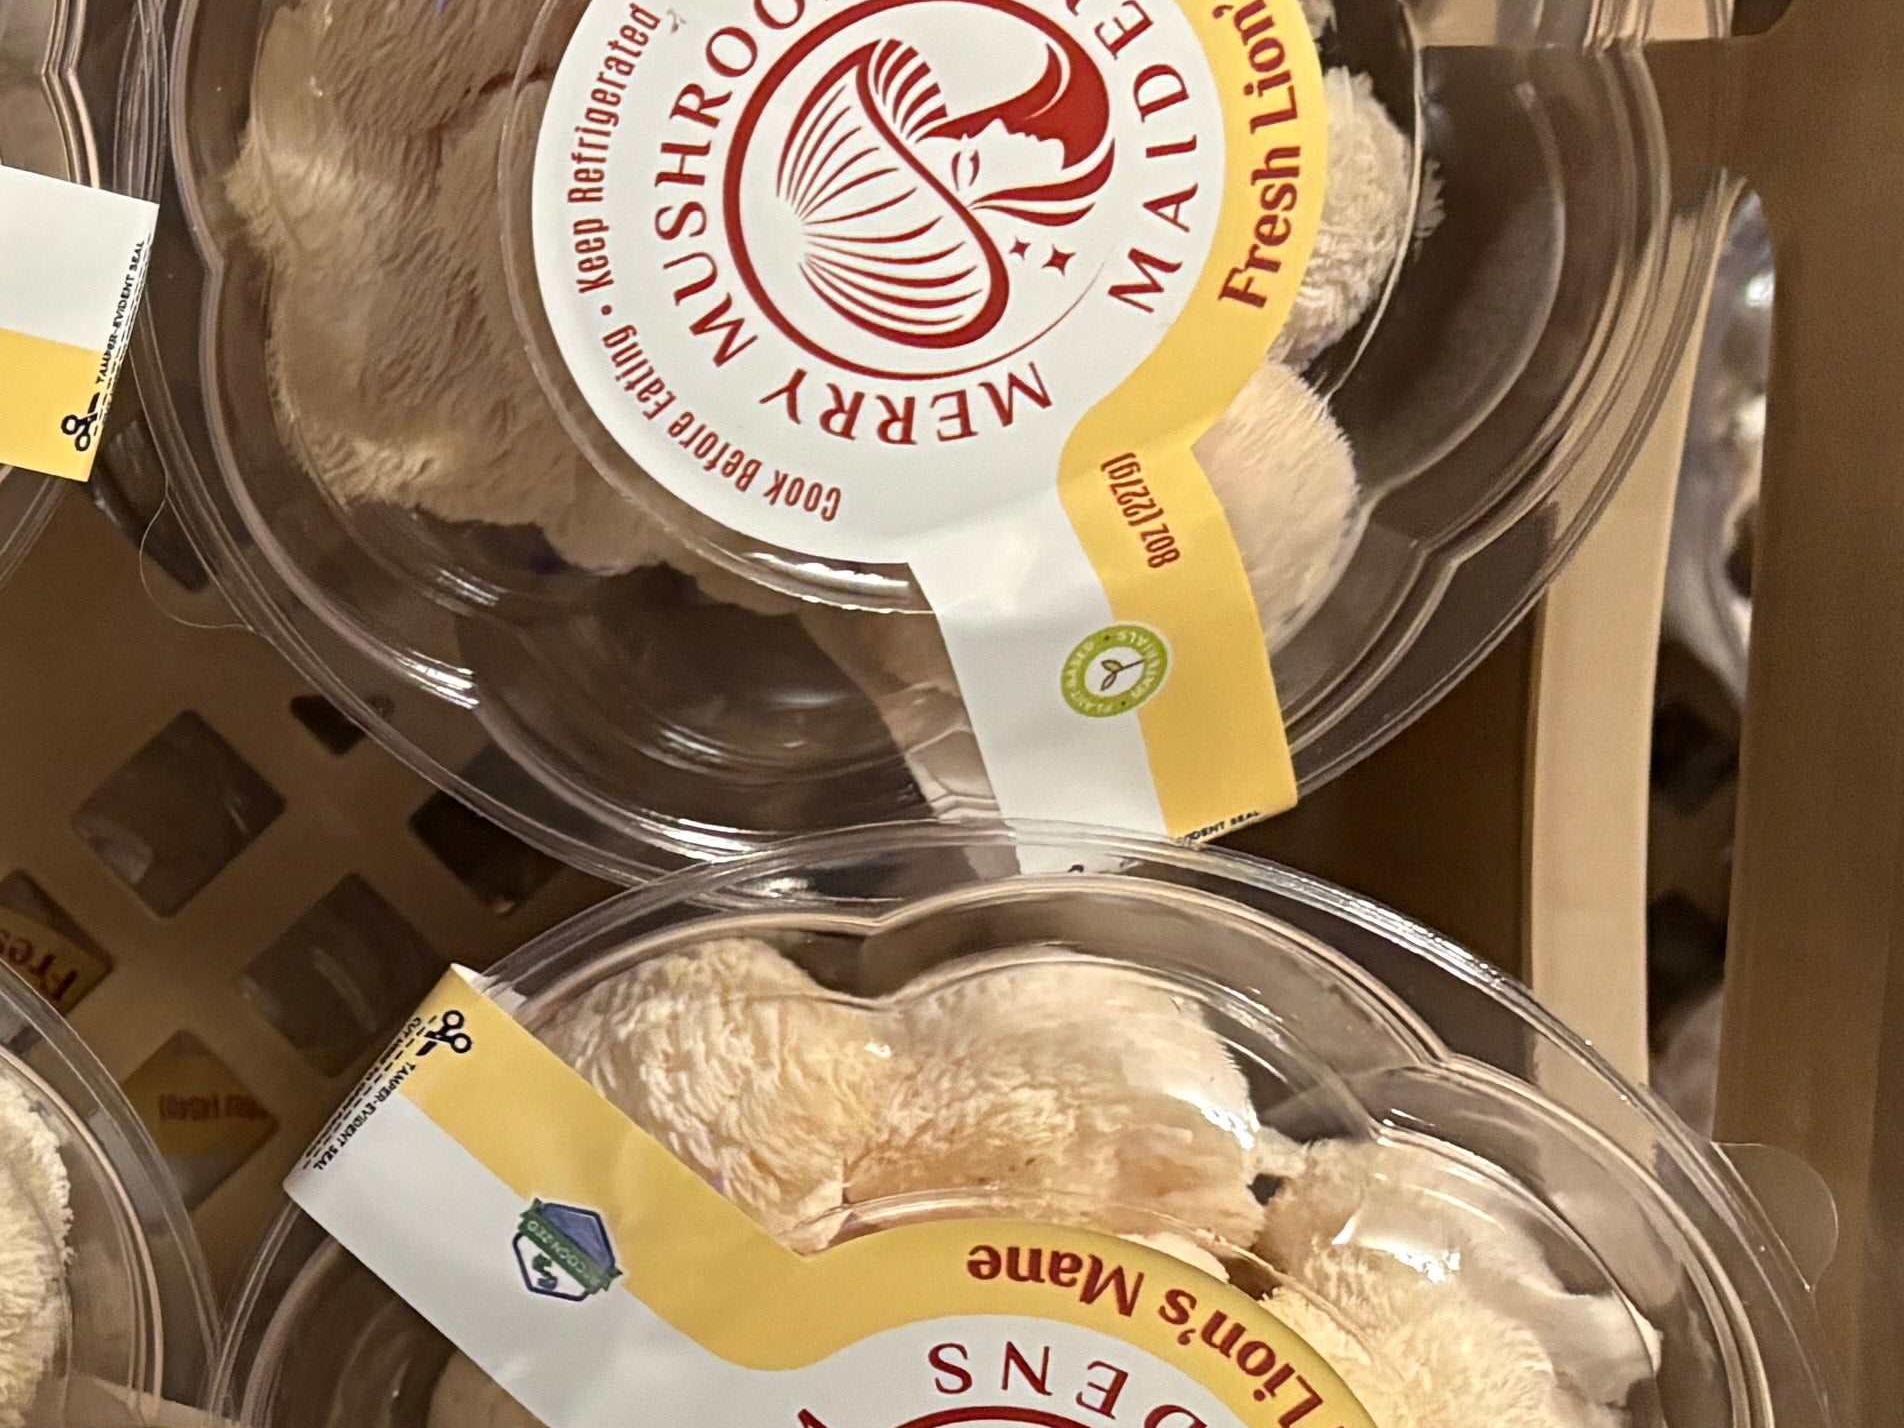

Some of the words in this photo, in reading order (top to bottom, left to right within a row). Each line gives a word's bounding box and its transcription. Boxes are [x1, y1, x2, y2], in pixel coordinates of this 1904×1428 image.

[567, 4, 660, 203] Refrigerated
[574, 219, 613, 293] Keep
[1218, 143, 1301, 306] Fresh
[603, 324, 675, 419] Eating
[761, 365, 1051, 444] MERRY
[668, 412, 762, 492] Before
[1100, 453, 1165, 527] (227g)
[766, 471, 841, 521] Cook
[1140, 523, 1181, 569] 8oz
[337, 1062, 416, 1147] TAMPER-EVIDENT
[965, 1243, 1143, 1316] Mane
